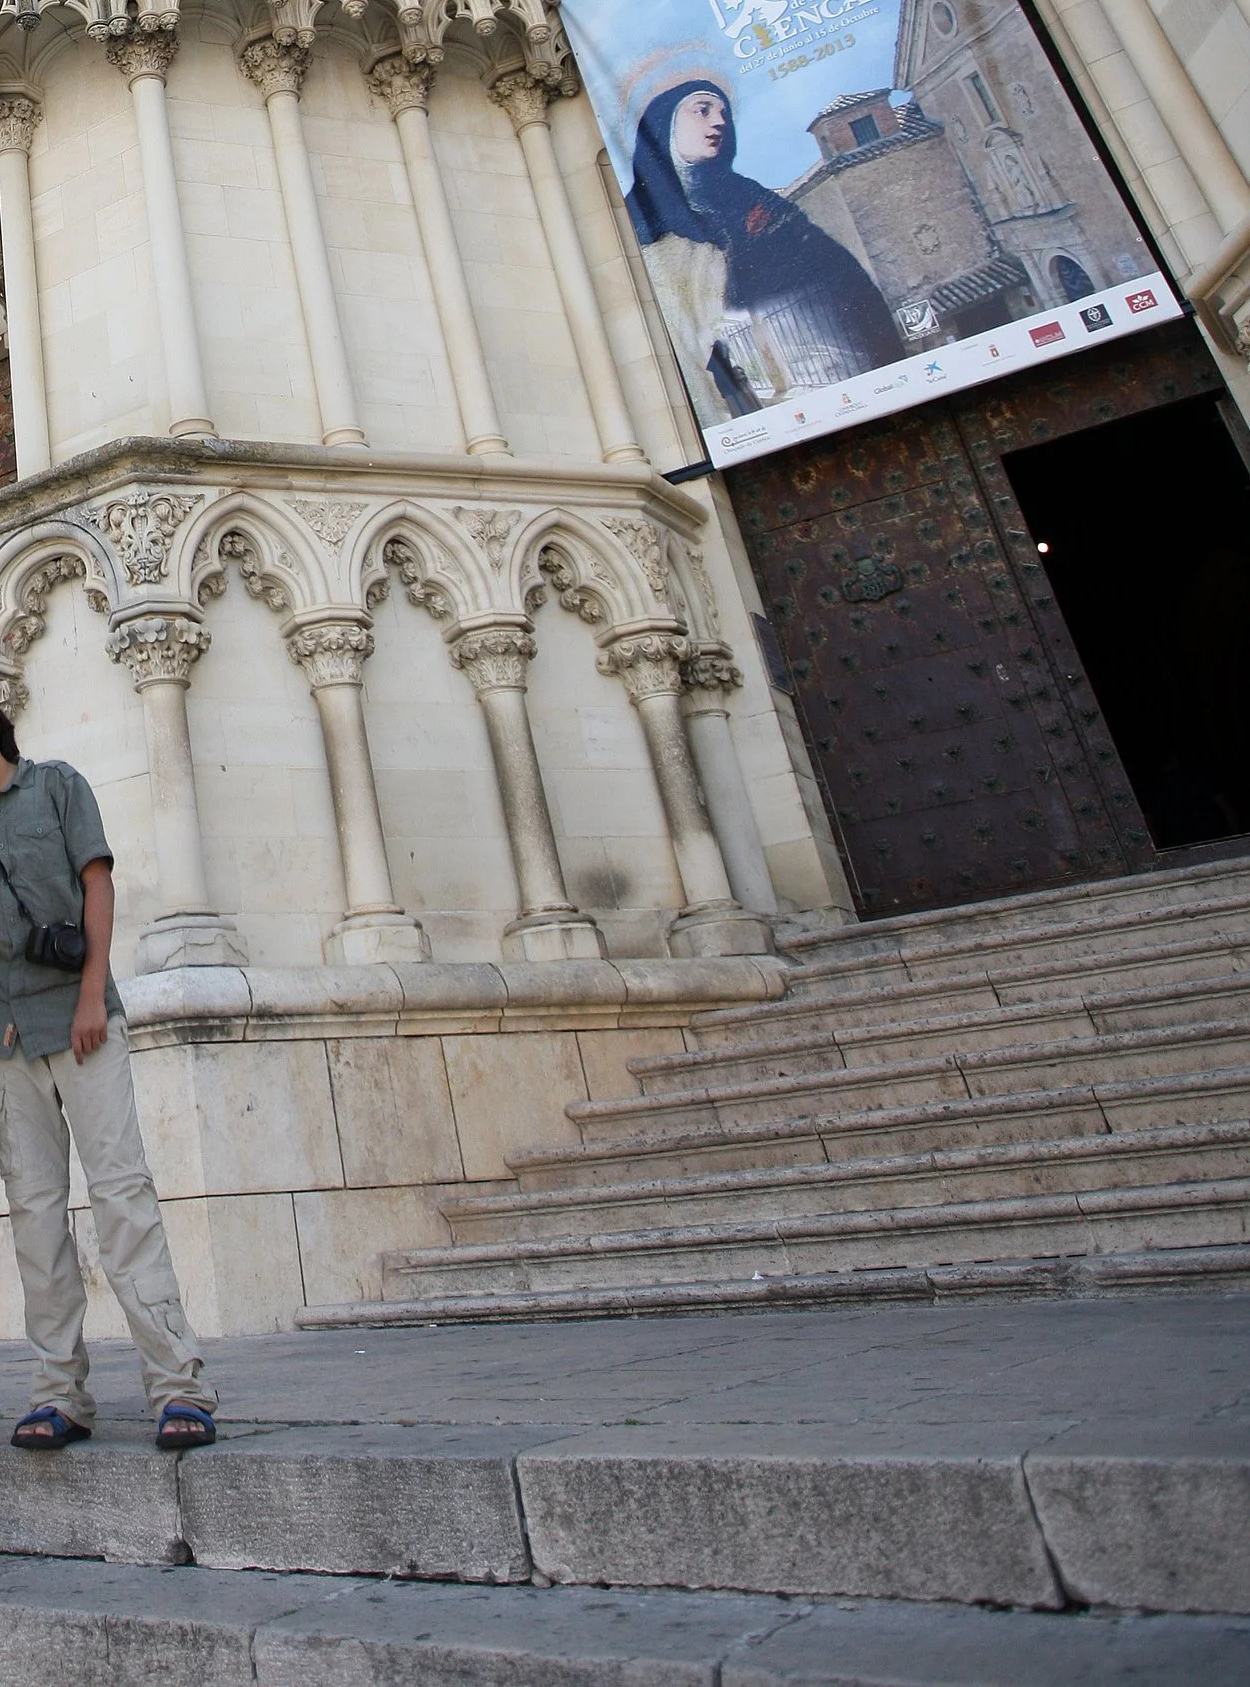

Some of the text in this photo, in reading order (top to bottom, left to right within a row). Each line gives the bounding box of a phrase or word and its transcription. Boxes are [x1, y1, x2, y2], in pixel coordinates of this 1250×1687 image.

[739, 7, 879, 75] del 27 de Junio al 15 de Octubre
[768, 33, 856, 81] 1588-2013
[1133, 299, 1155, 311] CCM
